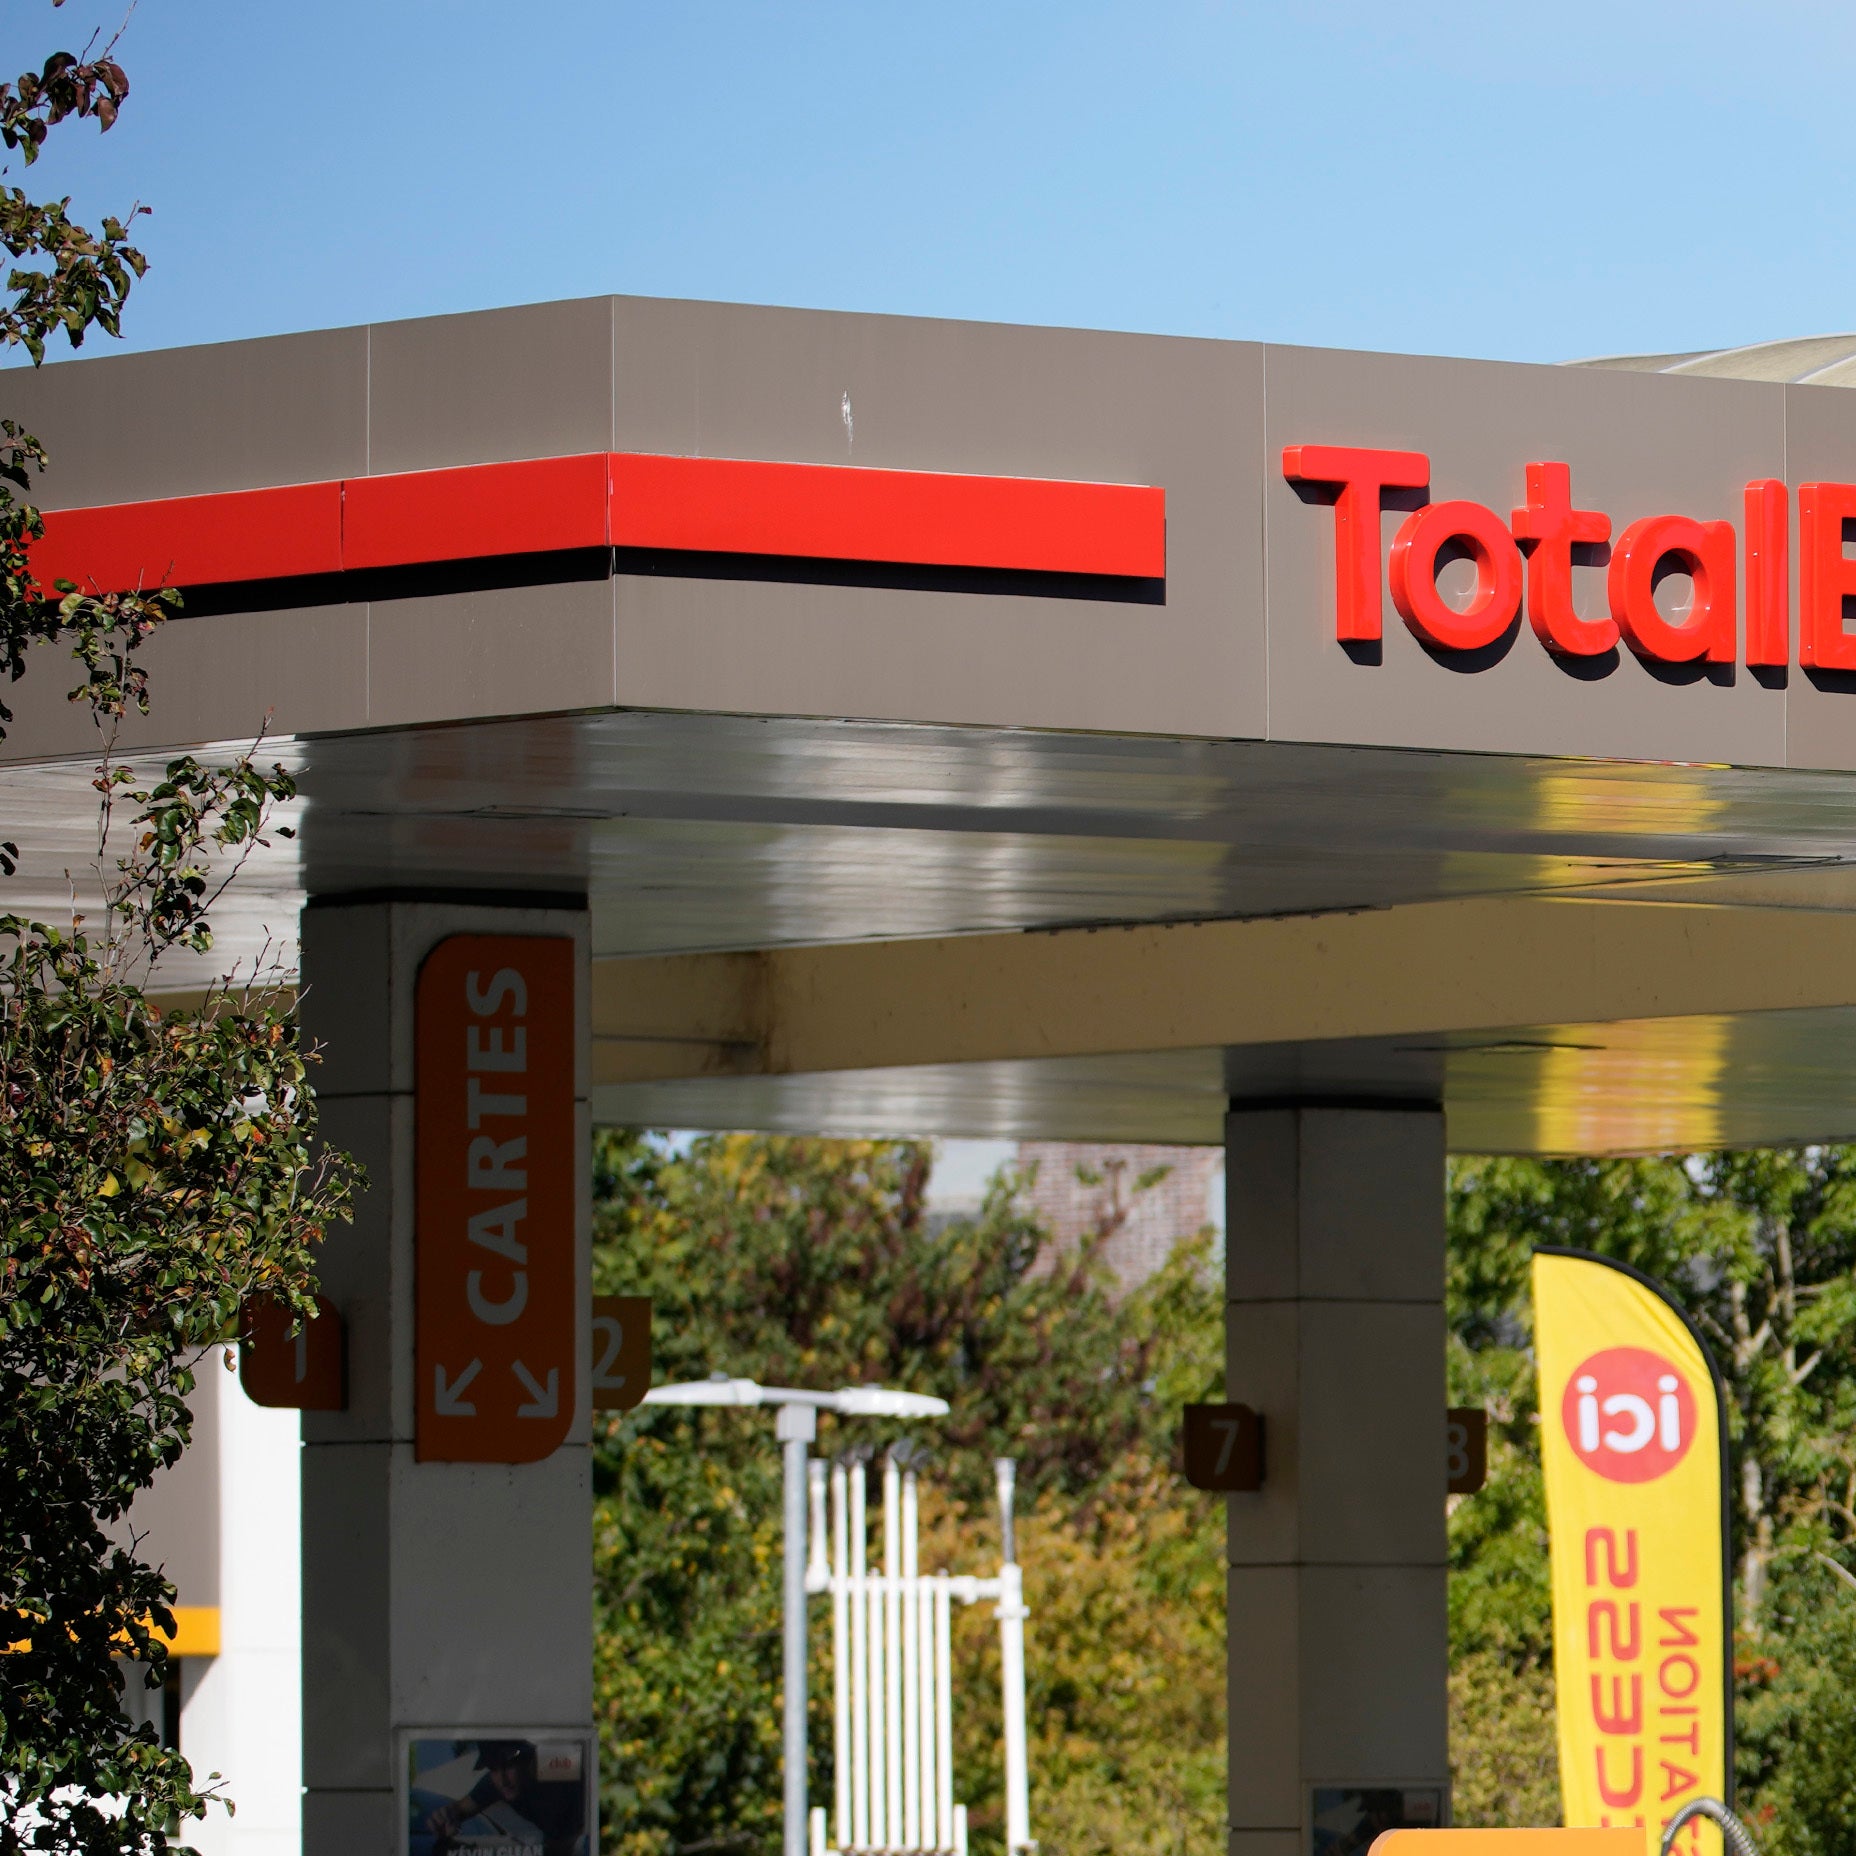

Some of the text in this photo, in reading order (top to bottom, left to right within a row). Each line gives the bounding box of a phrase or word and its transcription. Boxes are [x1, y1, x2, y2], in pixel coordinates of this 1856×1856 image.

[467, 966, 529, 1327] CARTES
[594, 1317, 625, 1390] 2
[1210, 1419, 1240, 1477] 7
